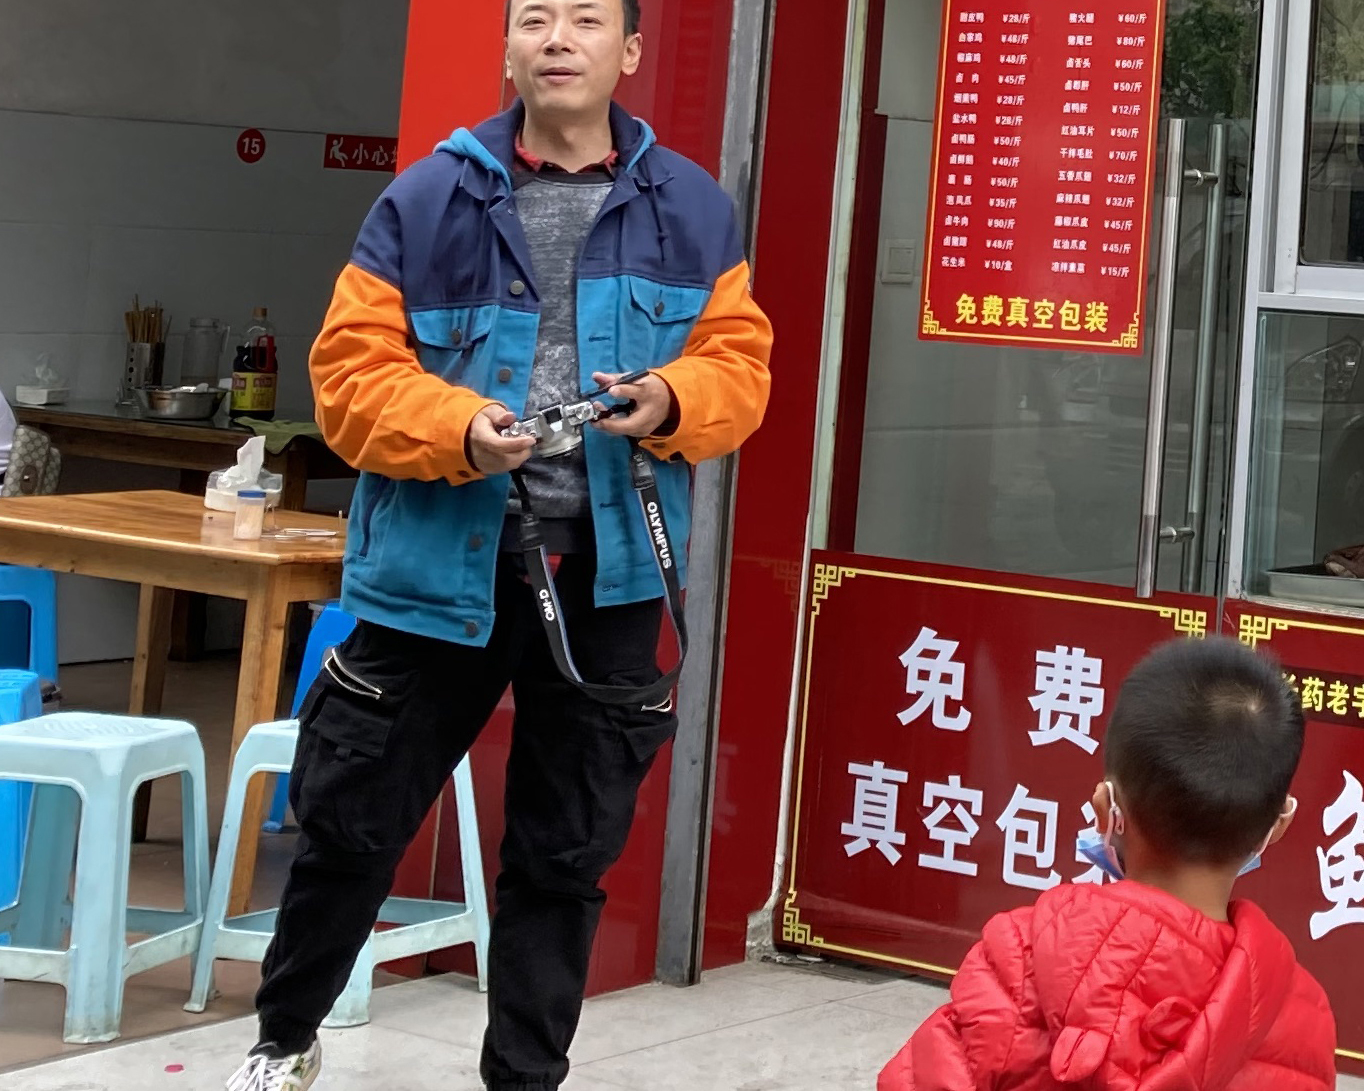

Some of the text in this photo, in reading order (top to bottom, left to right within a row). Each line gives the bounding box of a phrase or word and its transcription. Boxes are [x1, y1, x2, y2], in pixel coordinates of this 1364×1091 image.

[242, 137, 261, 155] 15
[944, 215, 969, 226] 卤牛肉
[941, 257, 966, 268] 花生米
[955, 293, 1110, 334] 免费真空包装
[646, 501, 672, 569] OLYMPUS
[538, 588, 555, 621] OM-D
[896, 626, 1105, 755] 免费
